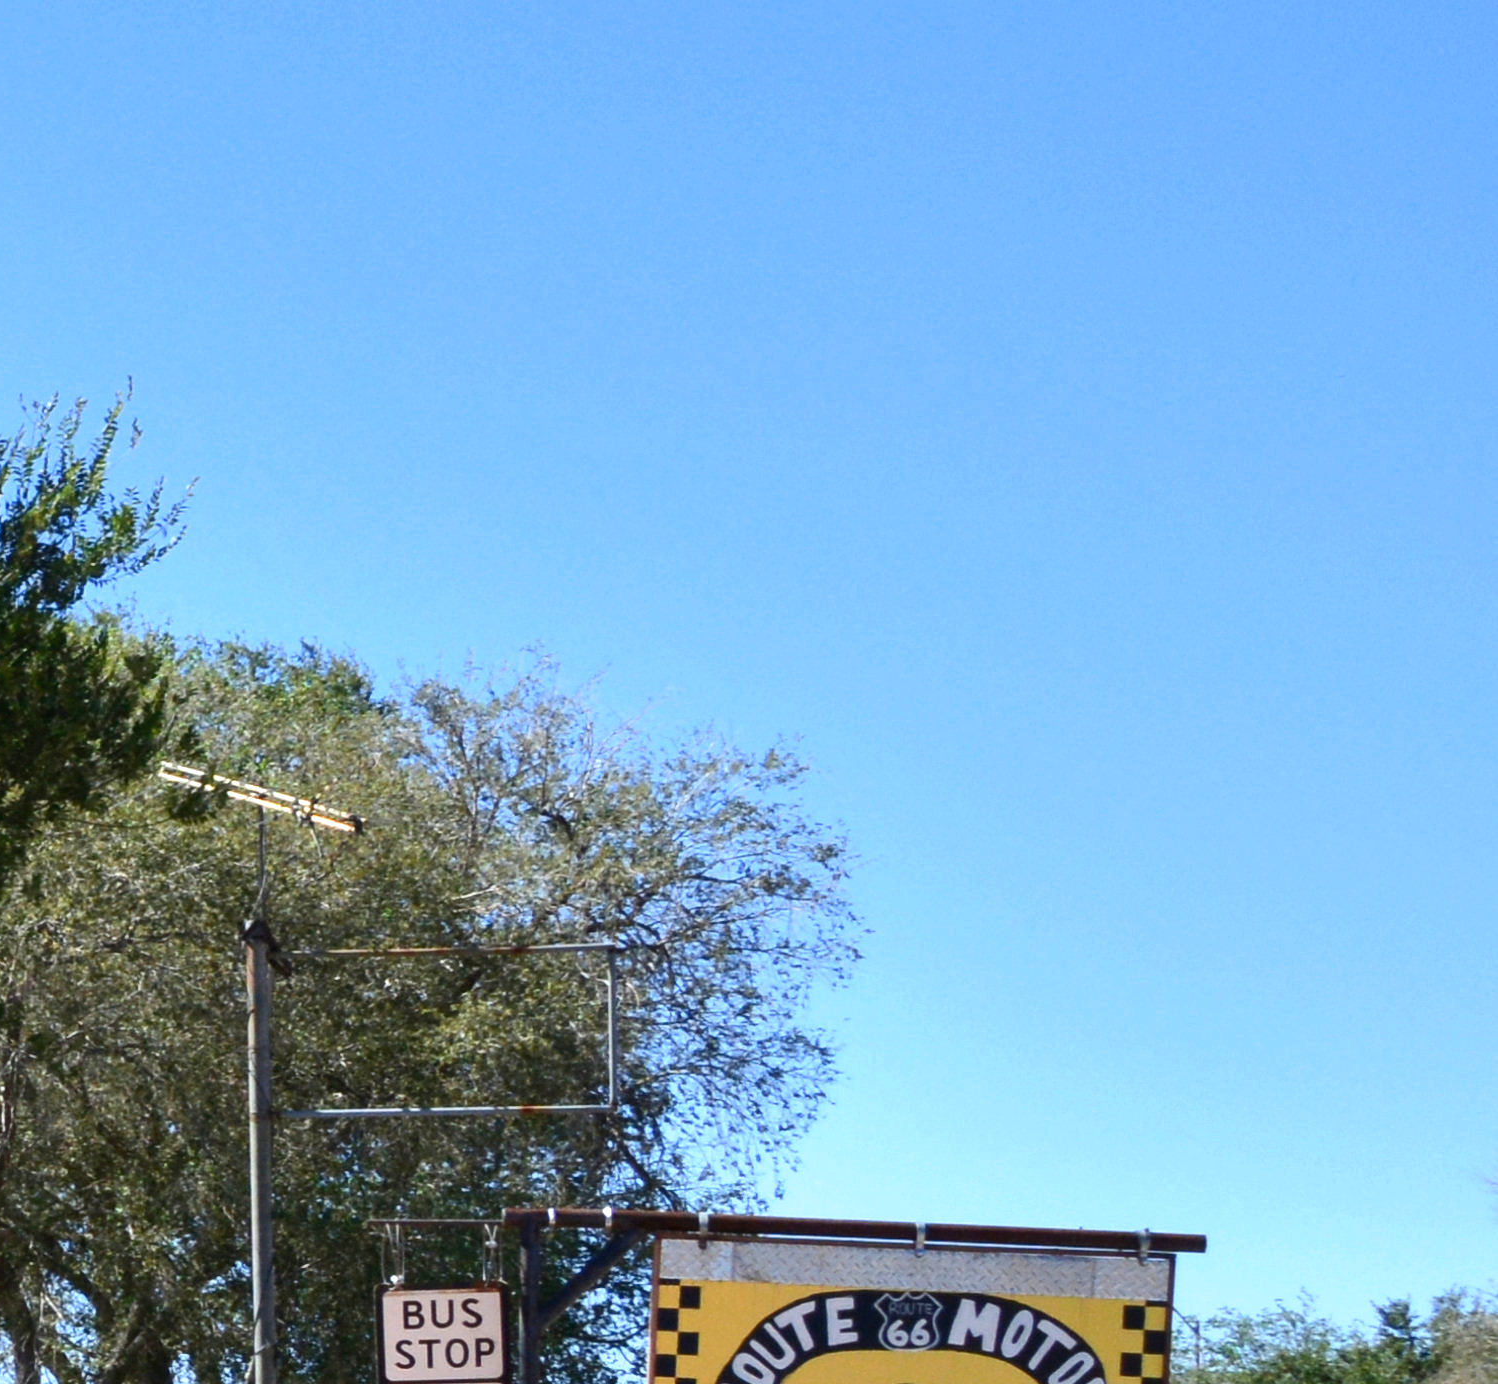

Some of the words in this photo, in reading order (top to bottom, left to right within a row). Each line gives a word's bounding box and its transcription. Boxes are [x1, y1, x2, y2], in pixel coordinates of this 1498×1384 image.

[402, 1298, 483, 1330] BUS
[888, 1301, 933, 1316] ROUTE
[886, 1319, 930, 1348] 66
[395, 1338, 495, 1370] STOP
